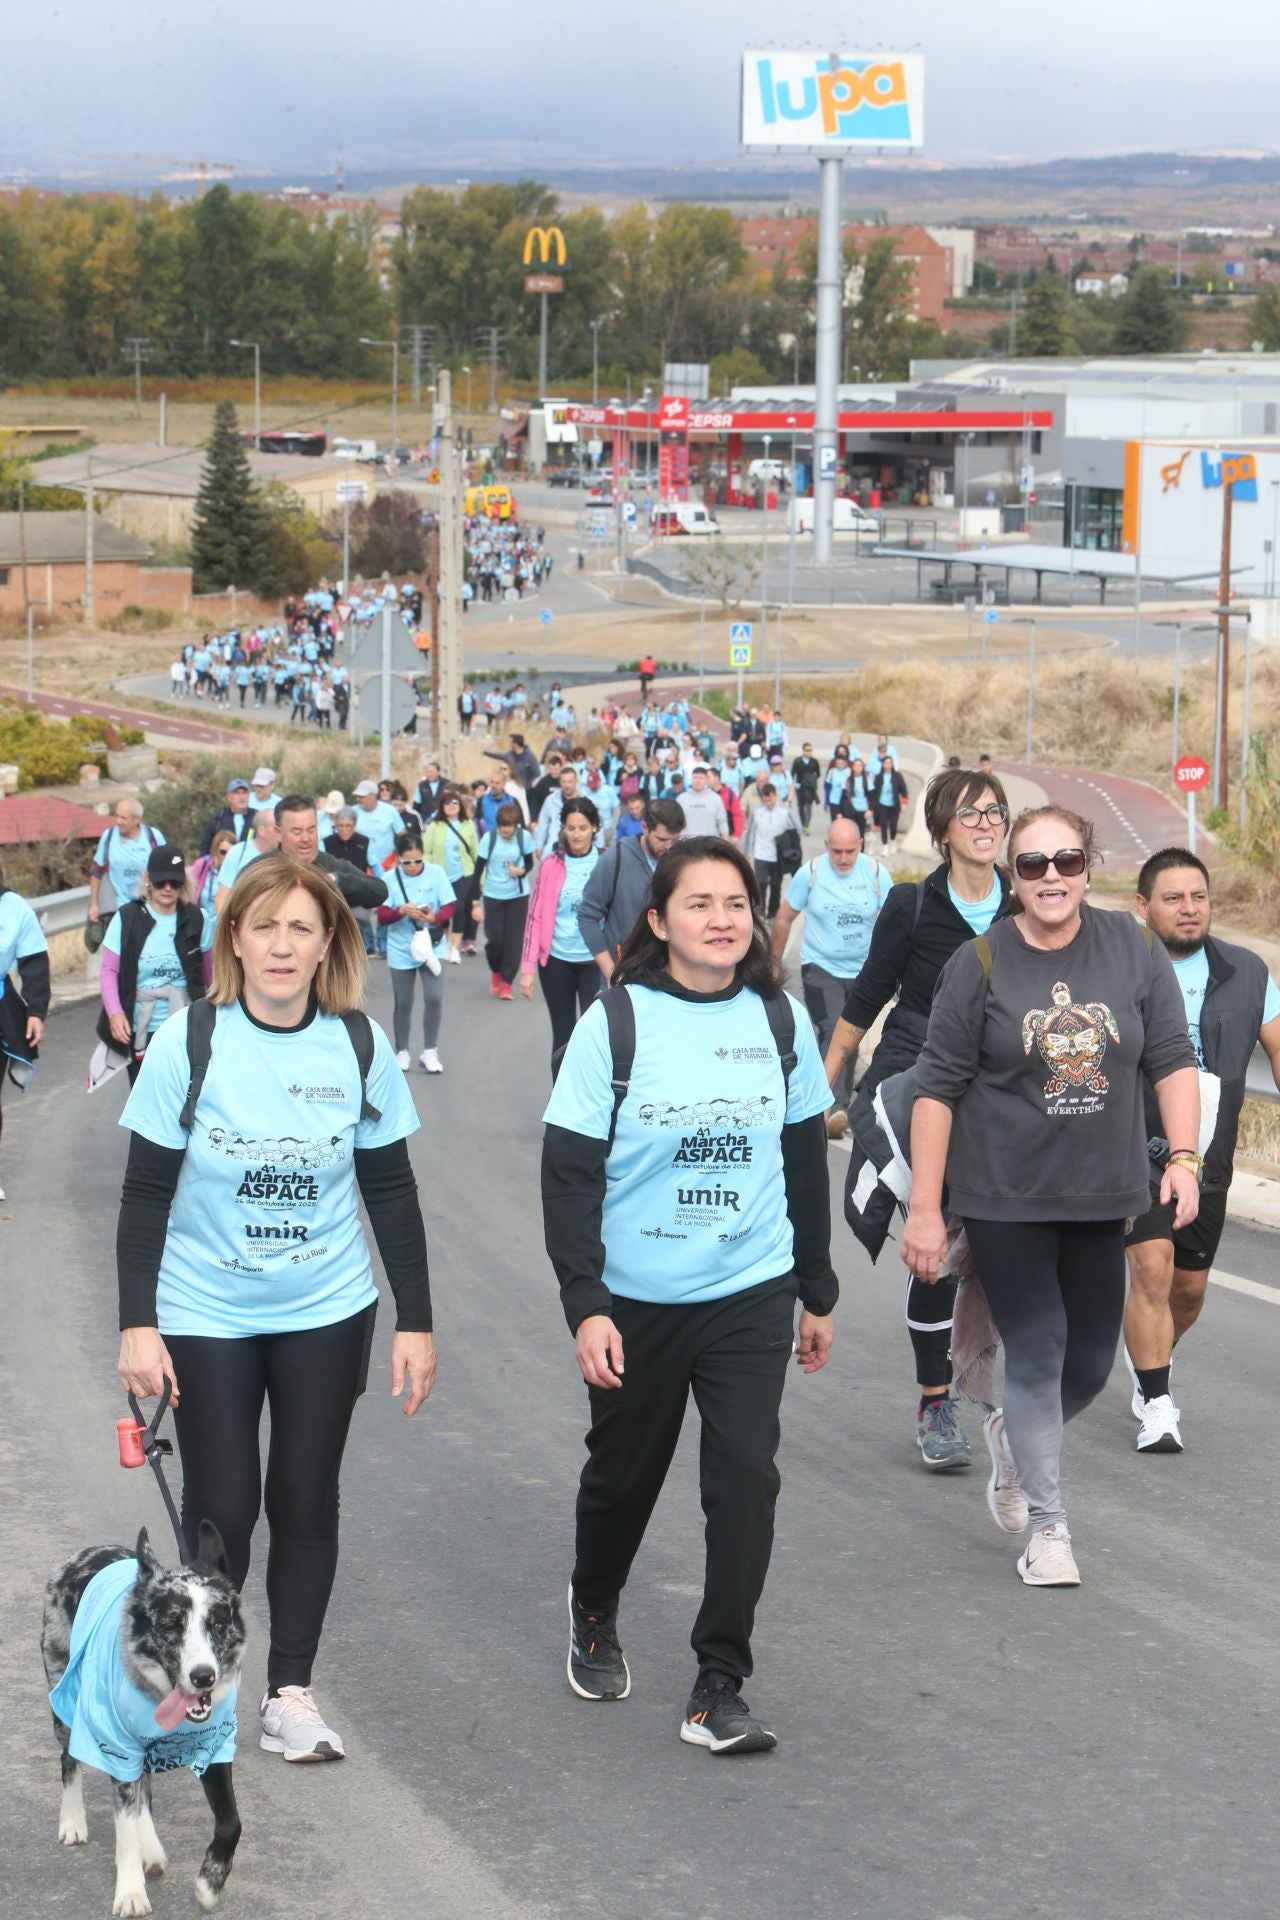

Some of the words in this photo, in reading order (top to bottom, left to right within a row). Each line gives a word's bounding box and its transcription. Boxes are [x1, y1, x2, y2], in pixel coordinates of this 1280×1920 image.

[757, 58, 907, 135] lupa
[688, 413, 734, 428] CEPSA
[820, 447, 837, 471] P
[1200, 451, 1257, 489] lupa
[1177, 767, 1205, 781] STOP
[1046, 1102, 1105, 1115] EVERYTHING
[680, 1132, 748, 1149] Marcha
[672, 1146, 753, 1162] ASPACE
[261, 1164, 276, 1173] 41
[244, 1170, 314, 1184] Marcha
[236, 1182, 319, 1200] ASPACE
[674, 1214, 727, 1222] INTERNACIONAL
[676, 1206, 719, 1215] UNIVERSIDAD
[301, 1253, 310, 1262] La
[312, 1246, 328, 1259] Rioja
